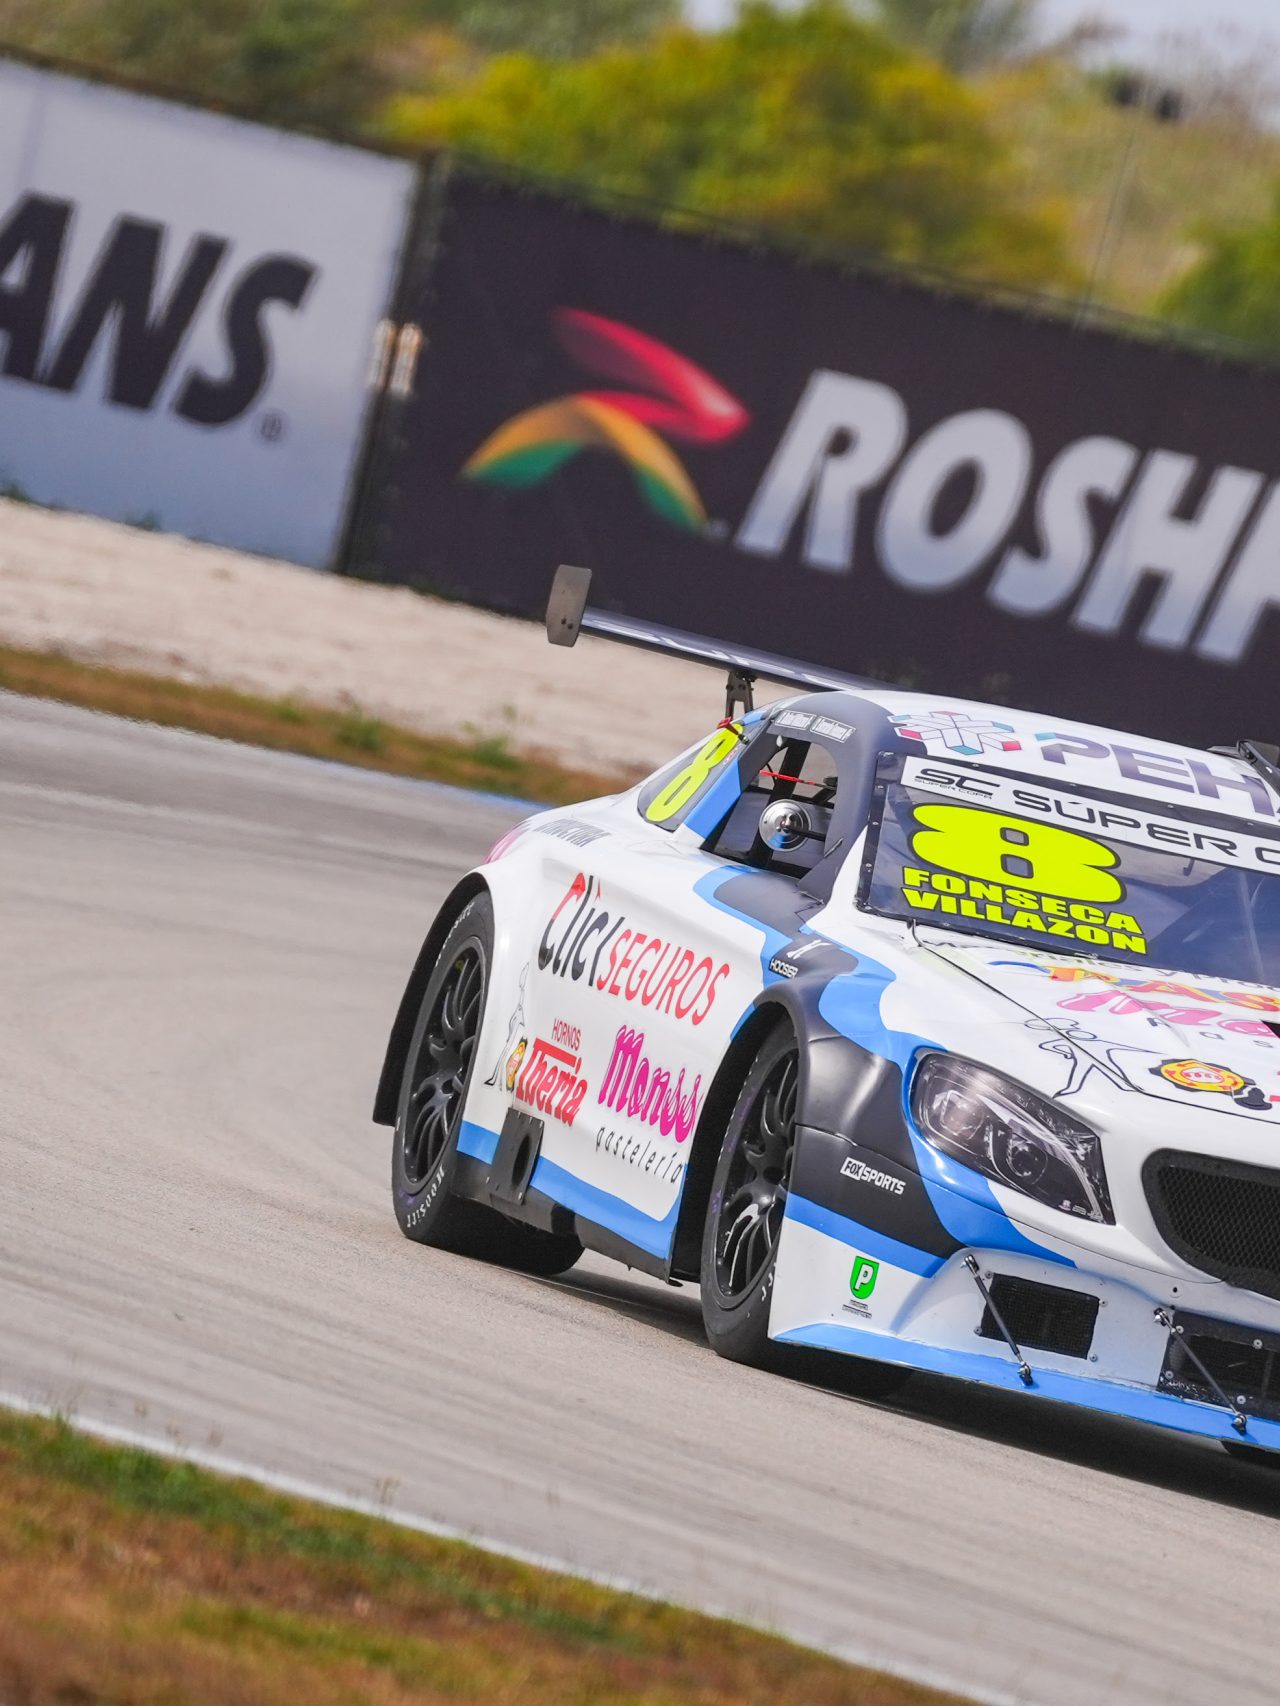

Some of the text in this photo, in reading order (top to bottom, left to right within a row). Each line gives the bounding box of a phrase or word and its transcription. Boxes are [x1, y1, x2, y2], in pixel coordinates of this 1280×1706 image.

[915, 768, 1000, 796] SC
[1011, 788, 1239, 858] SUPER
[909, 803, 1126, 904] 8
[901, 887, 1148, 955] VILLAZON
[902, 866, 1146, 935] FONSECA
[552, 1017, 582, 1051] HORNOS
[516, 1037, 588, 1127] Iberia
[844, 1160, 907, 1195] FOX SPORTS
